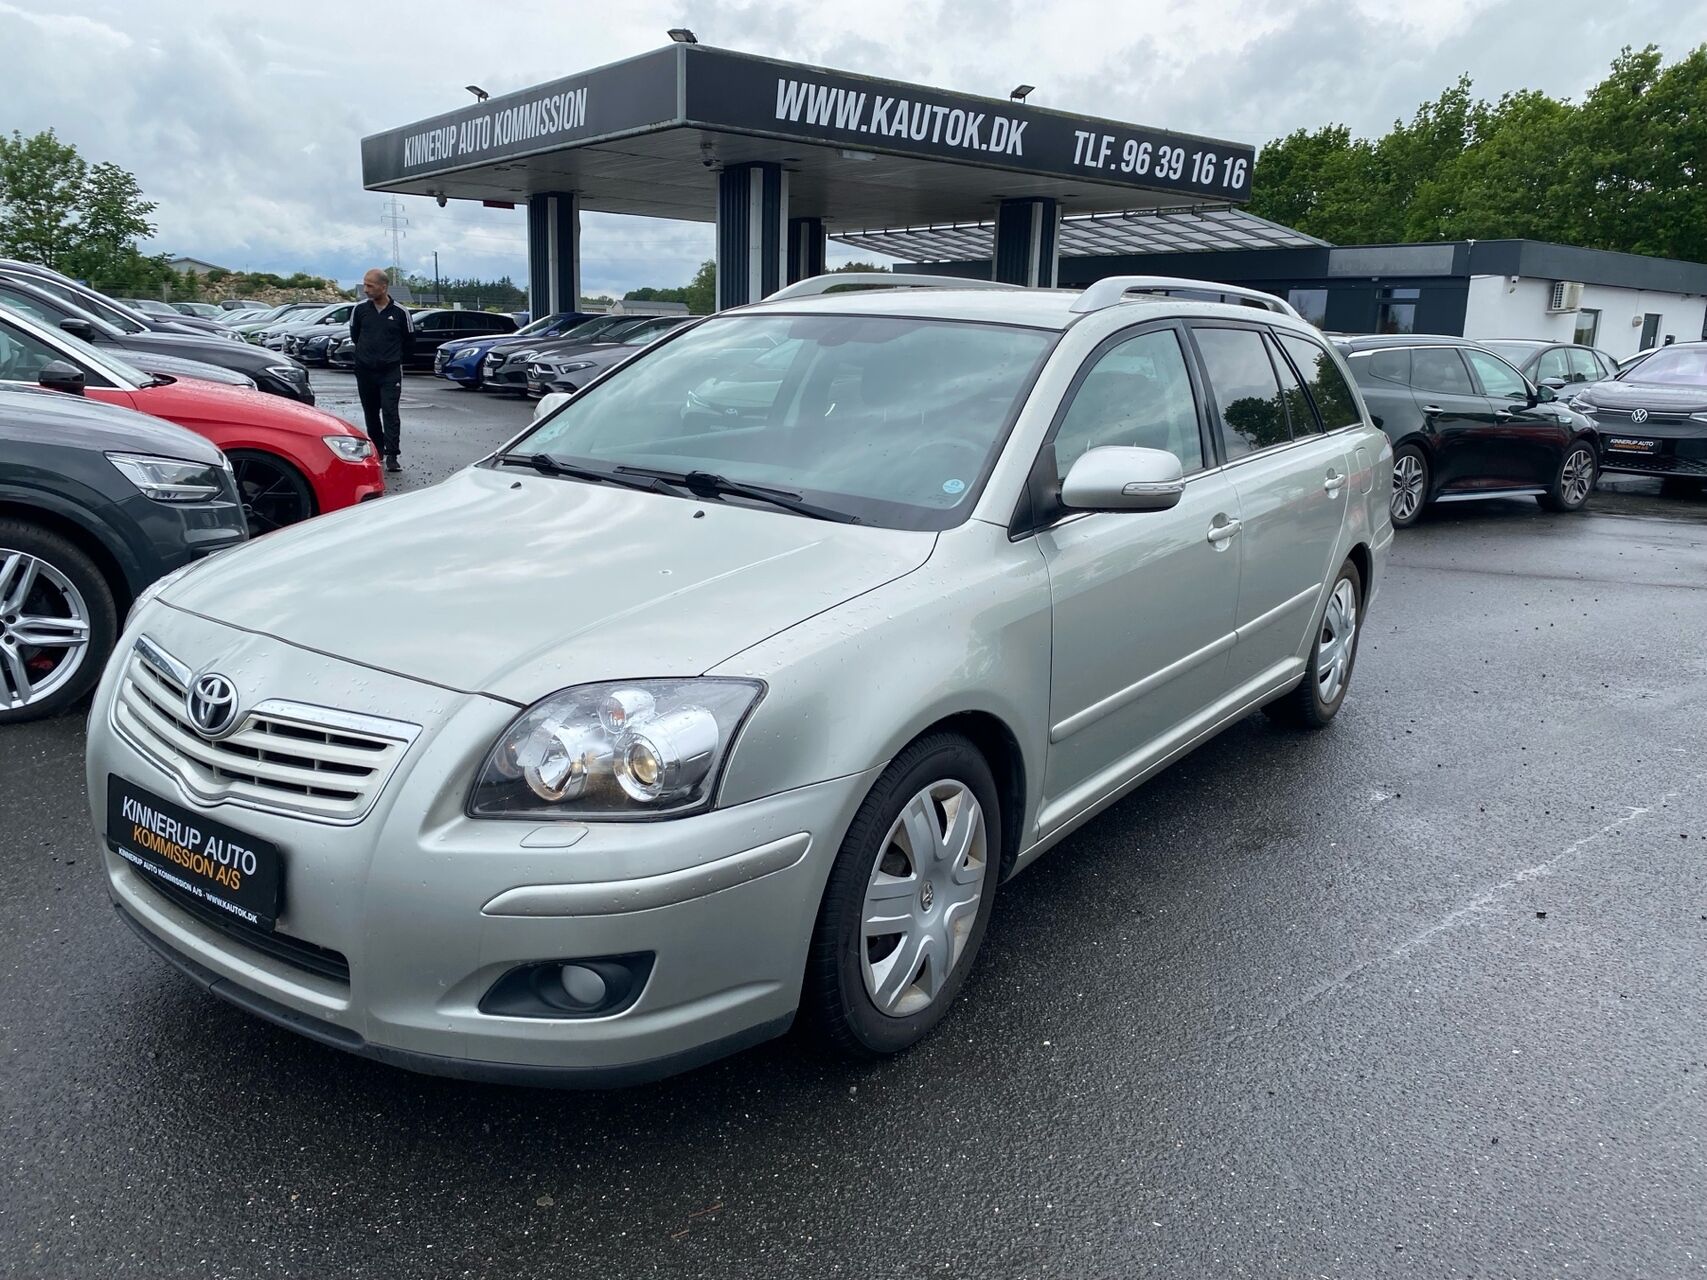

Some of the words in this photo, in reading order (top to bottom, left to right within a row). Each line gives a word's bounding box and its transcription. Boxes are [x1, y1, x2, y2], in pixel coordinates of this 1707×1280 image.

[404, 125, 457, 168] KINNERUP
[458, 115, 491, 155] AUTO
[493, 87, 588, 147] KOMMISSION
[775, 78, 1029, 156] WWW.KAUTOK.DK
[1073, 130, 1116, 170] TLF.
[1120, 139, 1152, 175] 96
[1154, 145, 1185, 180] 39
[1191, 151, 1217, 185] 16
[1222, 156, 1248, 189] 16
[118, 847, 143, 865] KINNERUP
[143, 861, 157, 874] AUTO
[158, 868, 192, 892] KOMMISSION
[122, 796, 201, 850] KINNERUP
[203, 836, 257, 876] AUTO
[132, 825, 214, 878] KOMMISSION
[216, 865, 241, 890] A/S
